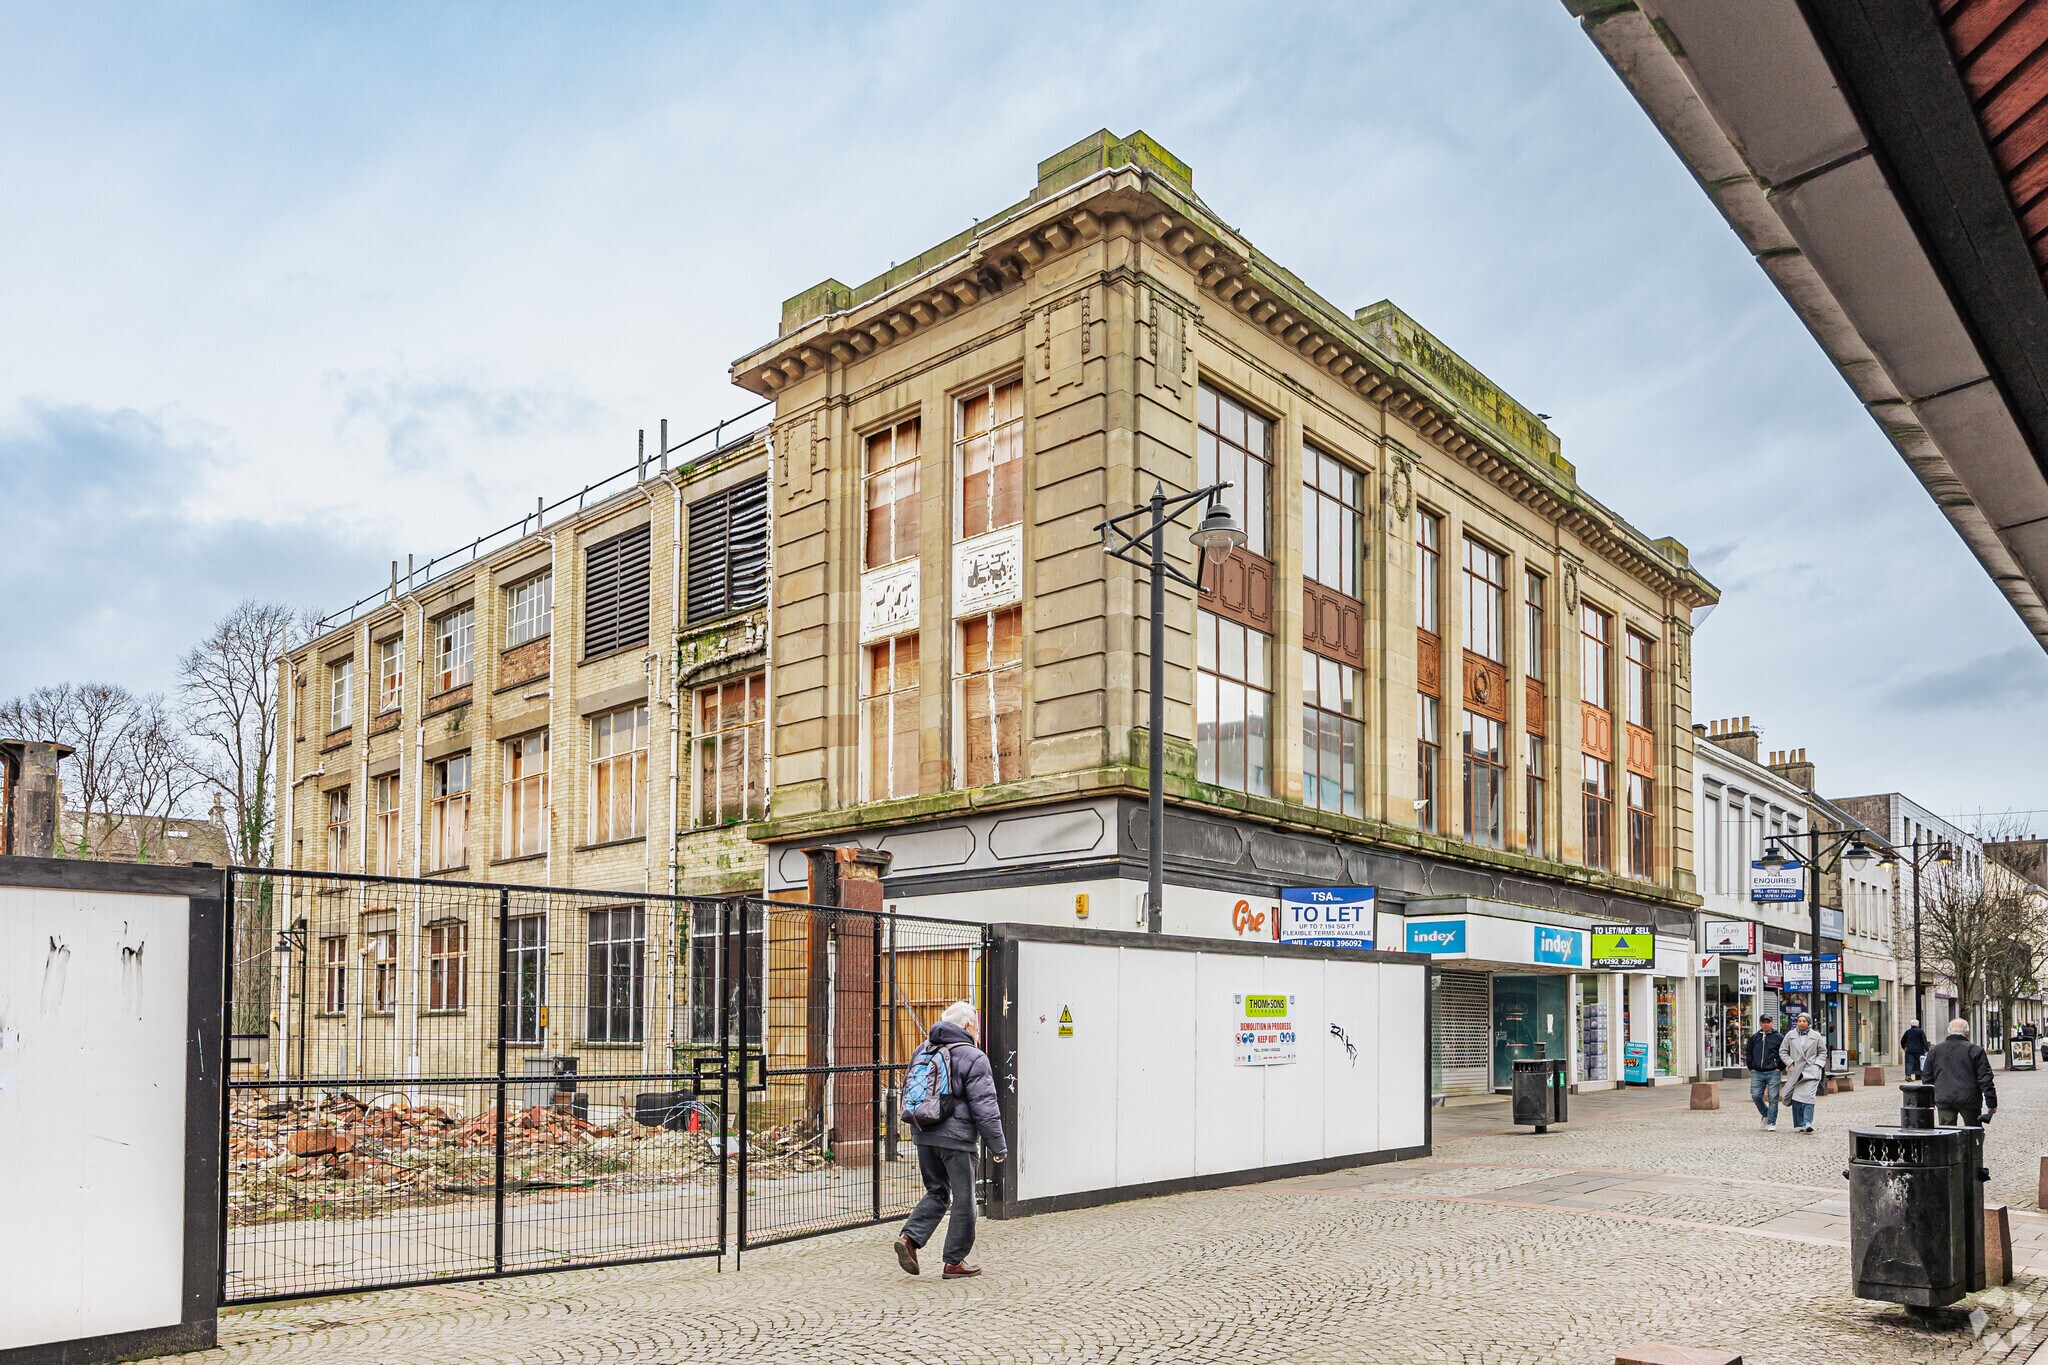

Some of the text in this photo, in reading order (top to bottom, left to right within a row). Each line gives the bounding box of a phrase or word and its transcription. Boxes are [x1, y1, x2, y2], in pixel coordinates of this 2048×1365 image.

[1311, 891, 1334, 902] TSA
[1290, 906, 1365, 922] TO LET
[1594, 926, 1651, 935] TO LET/MAY SELL
[1716, 927, 1740, 935] Future
[1413, 929, 1457, 946] index
[1313, 939, 1335, 947] 07581
[1336, 940, 1363, 948] 396092
[1540, 930, 1574, 962] index
[1793, 963, 1803, 971] LET
[1240, 1022, 1292, 1031] DEMOLITION IN PROGRESS
[1257, 1035, 1268, 1043] KEEP
